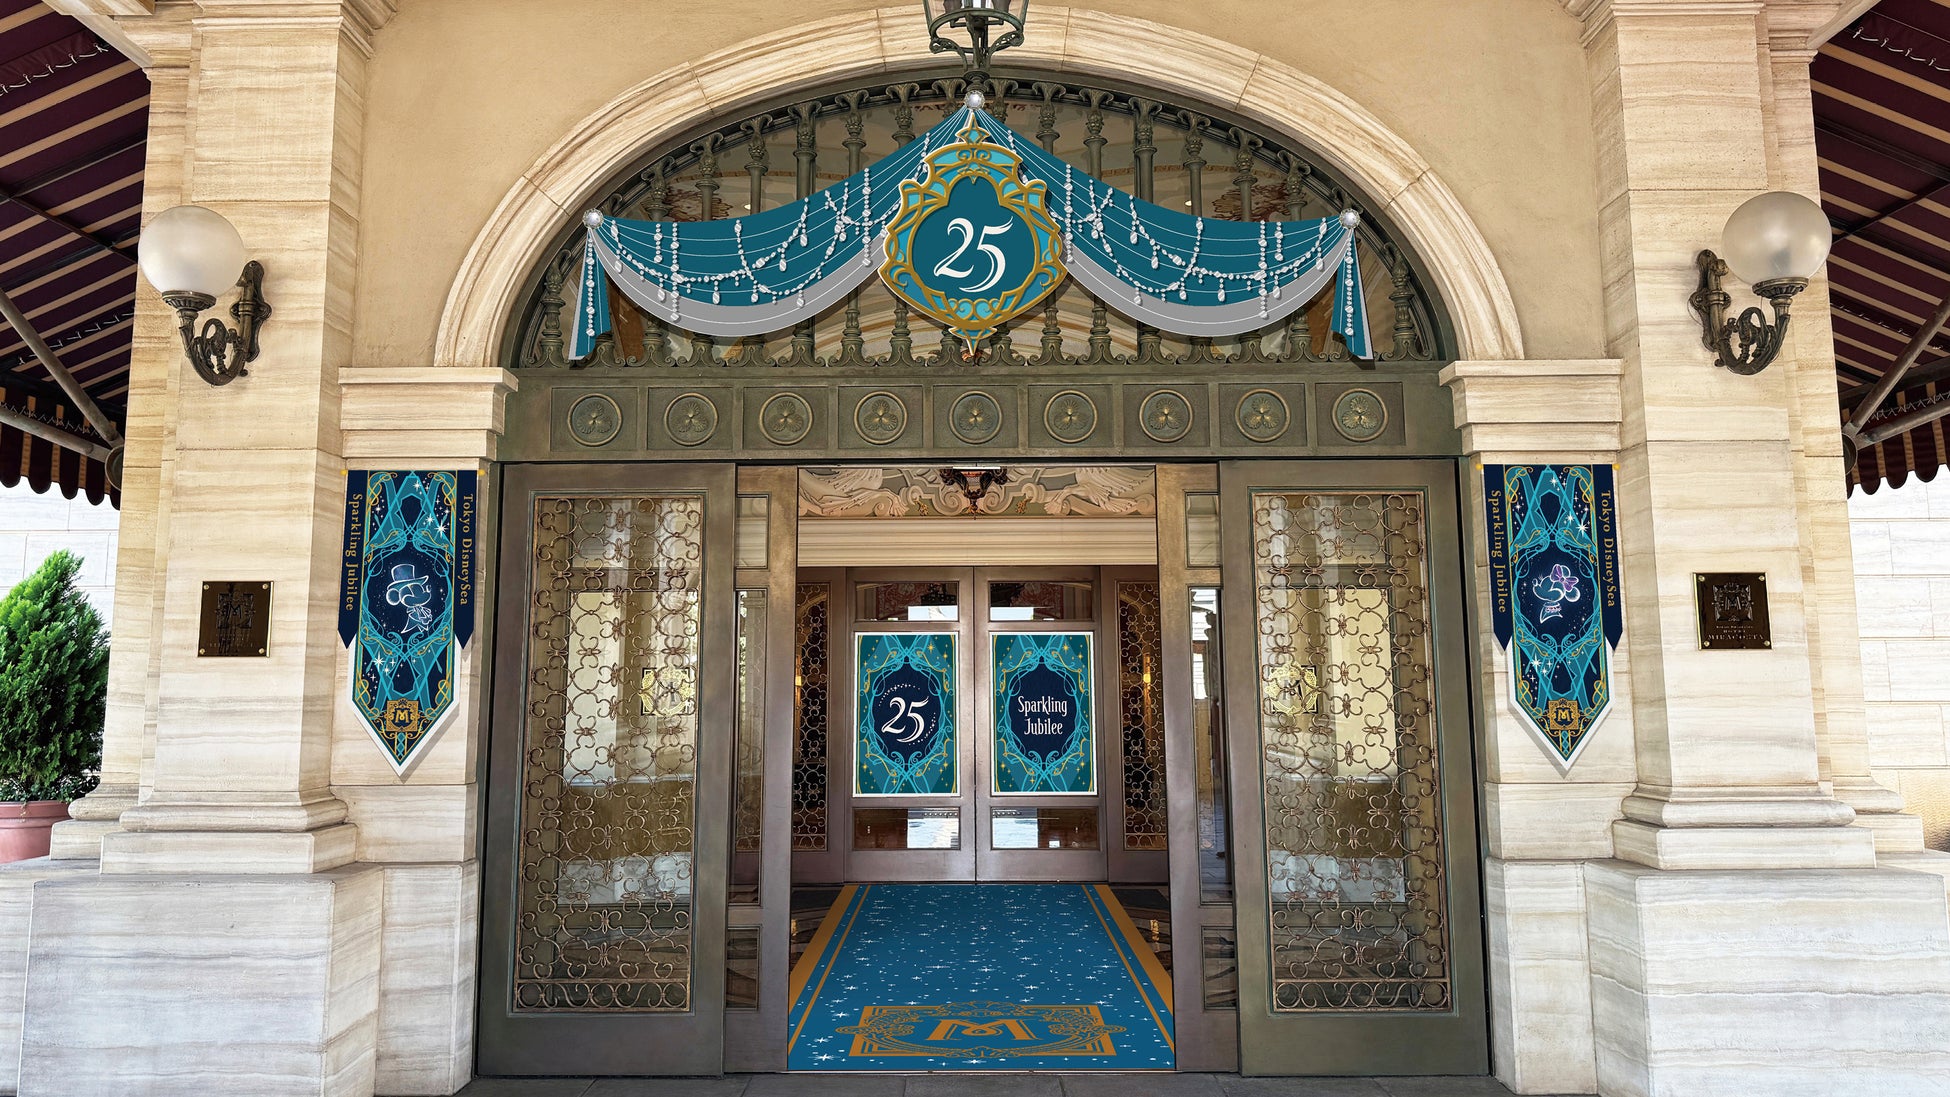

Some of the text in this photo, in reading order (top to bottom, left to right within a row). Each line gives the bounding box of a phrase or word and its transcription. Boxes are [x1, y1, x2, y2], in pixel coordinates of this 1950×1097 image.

[933, 216, 1013, 293] 25
[345, 493, 363, 611] Sparkling Jubilee
[457, 493, 474, 605] Tokyo DisneySea
[1488, 490, 1508, 613] Sparkling Jubilee
[1599, 490, 1617, 607] Tokyo DisneySea
[881, 696, 929, 743] 25
[1017, 695, 1068, 717] Sparkling
[1023, 717, 1063, 735] Jubilee
[924, 1018, 1043, 1041] M
